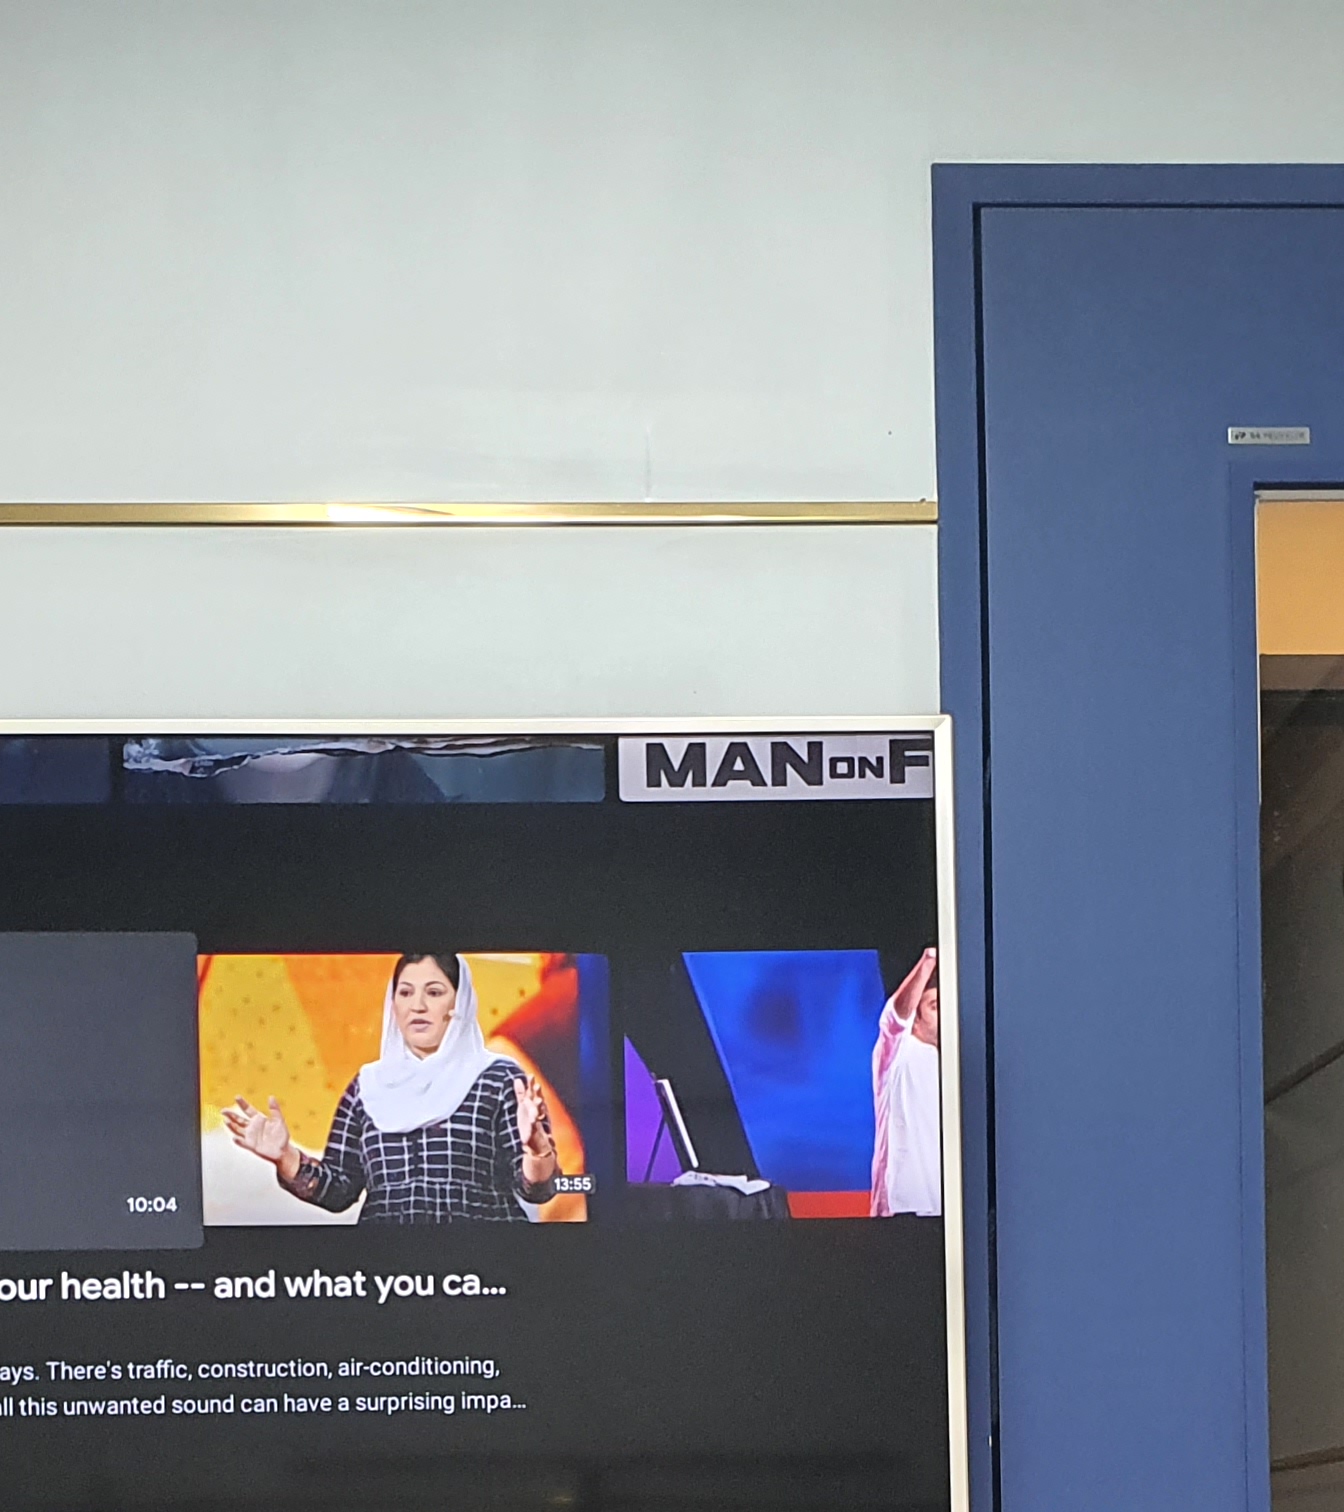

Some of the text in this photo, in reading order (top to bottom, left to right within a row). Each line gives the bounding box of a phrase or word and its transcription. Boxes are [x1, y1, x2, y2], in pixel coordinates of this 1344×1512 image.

[554, 1177, 592, 1191] 13:55
[126, 1196, 178, 1213] 10:04
[61, 1270, 166, 1301] health
[213, 1269, 276, 1299] and
[283, 1268, 367, 1298] what
[373, 1274, 435, 1304] you
[45, 1360, 123, 1381] There's
[126, 1358, 193, 1381] traffic,
[197, 1358, 333, 1380] construction,
[337, 1356, 500, 1379] air-conditioning,
[18, 1396, 58, 1417] this
[63, 1394, 166, 1416] unwanted
[171, 1393, 235, 1414] sound
[240, 1398, 278, 1413] can
[283, 1393, 332, 1413] have
[337, 1397, 350, 1412] a
[355, 1391, 455, 1416] surprising
